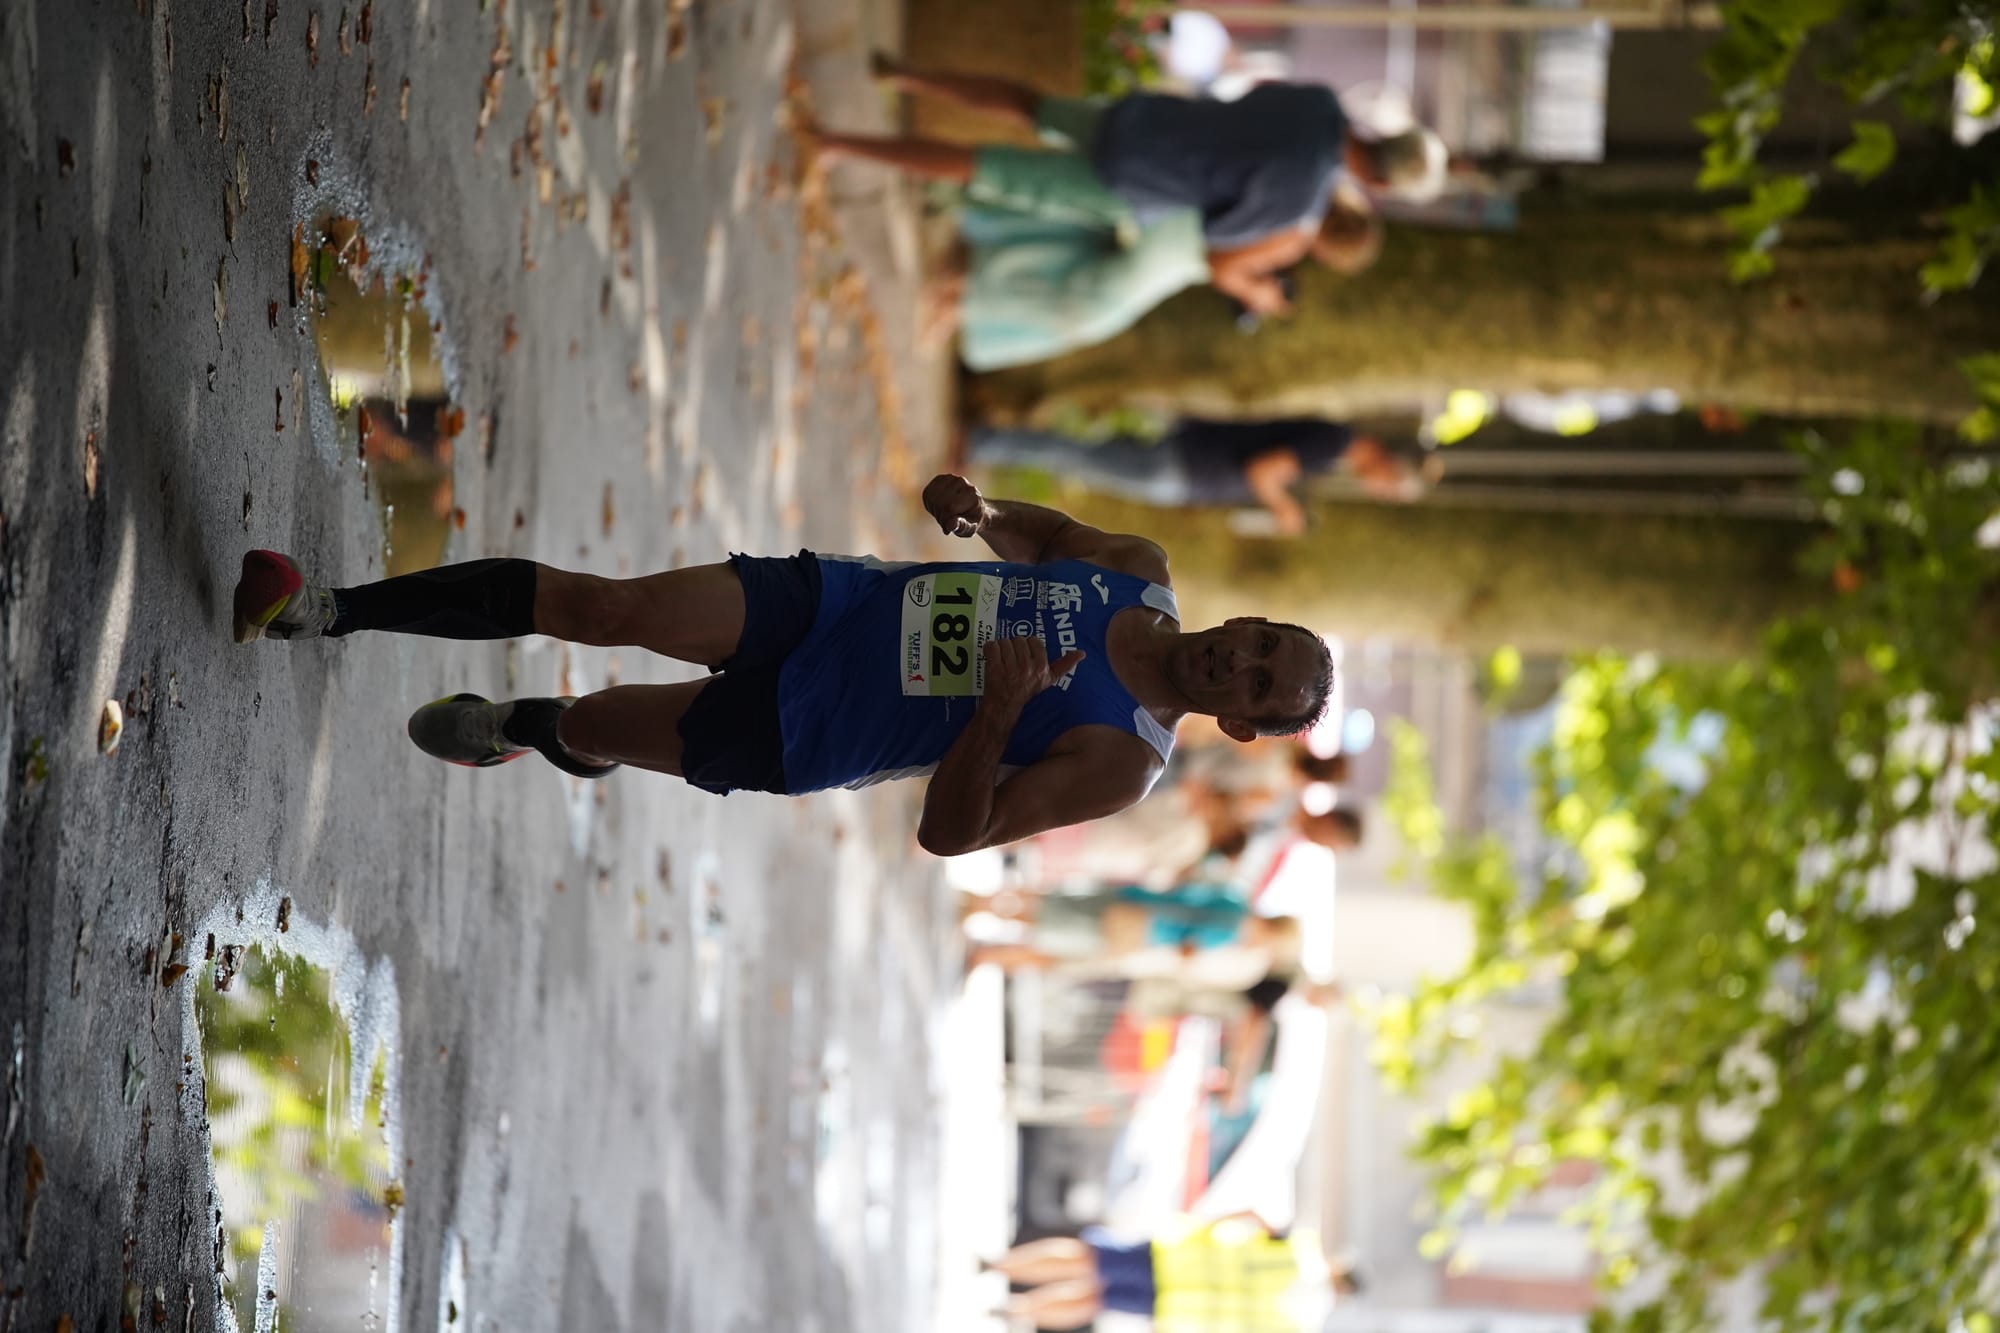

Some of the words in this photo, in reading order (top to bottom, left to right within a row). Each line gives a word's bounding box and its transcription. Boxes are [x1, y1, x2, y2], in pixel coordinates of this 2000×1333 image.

[912, 630, 920, 670] TUFF'S
[932, 588, 972, 676] 182
[1016, 624, 1028, 636] U
